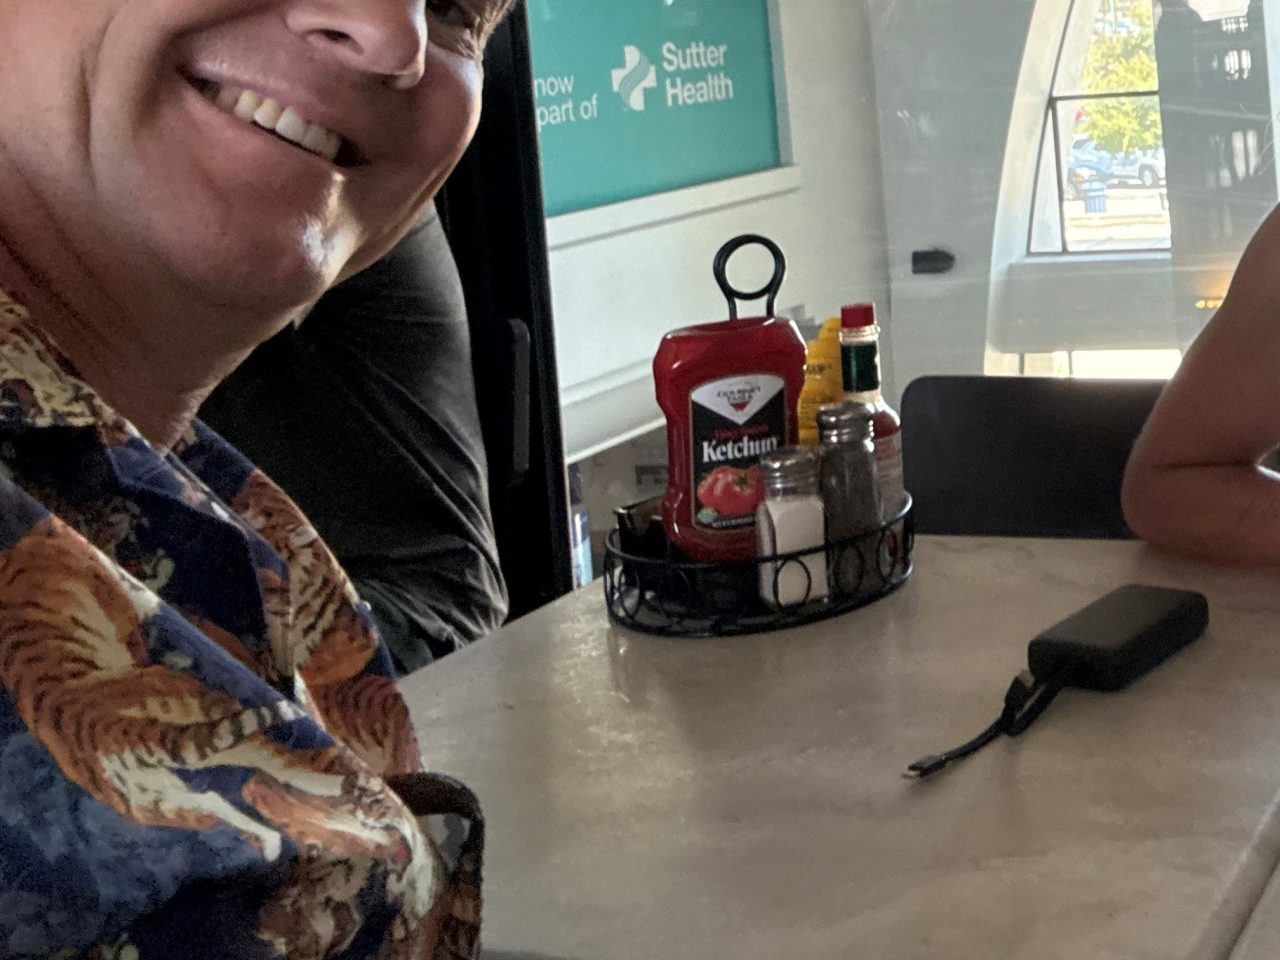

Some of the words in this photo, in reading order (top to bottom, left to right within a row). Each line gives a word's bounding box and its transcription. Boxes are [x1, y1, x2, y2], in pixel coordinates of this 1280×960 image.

[662, 41, 727, 72] Sutter
[534, 74, 575, 97] now
[665, 73, 734, 107] Health
[536, 99, 576, 132] part
[580, 93, 598, 120] of
